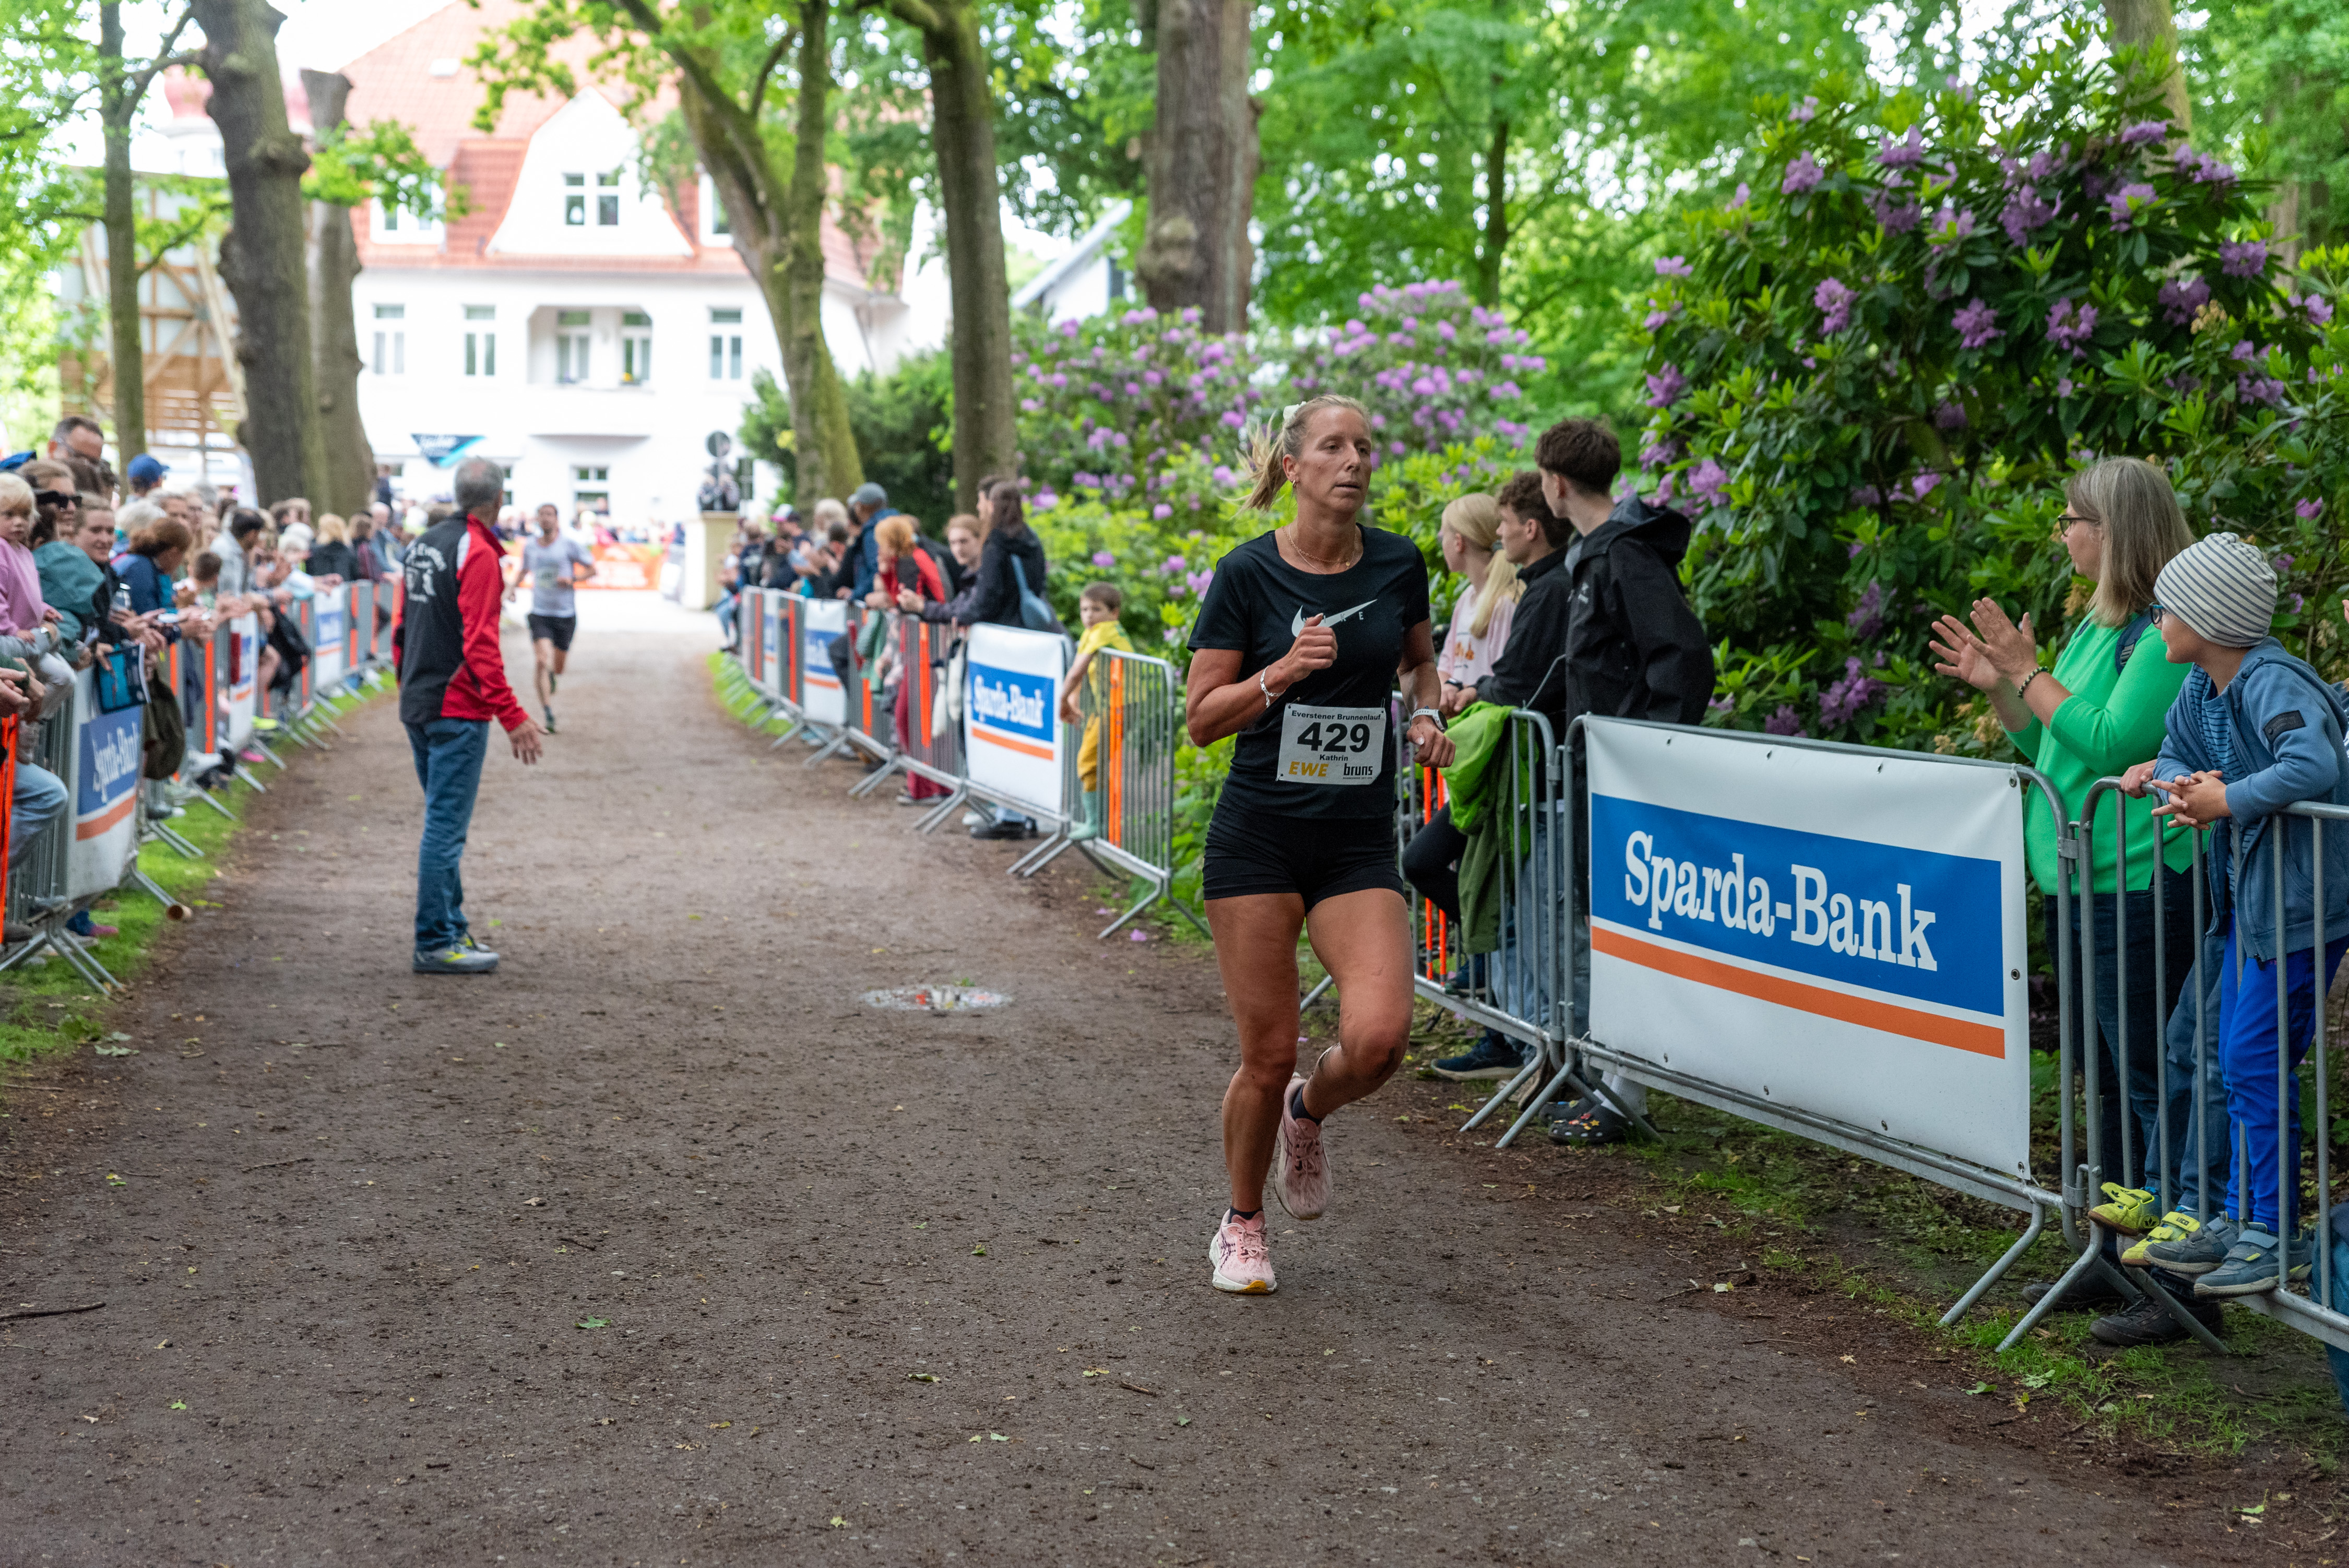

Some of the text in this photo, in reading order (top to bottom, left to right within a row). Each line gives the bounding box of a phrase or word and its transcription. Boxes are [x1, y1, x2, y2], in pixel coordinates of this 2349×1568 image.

[974, 675, 1045, 729] Sparda-Bank
[1291, 710, 1335, 720] Everstener
[1297, 722, 1370, 753] 429
[1288, 761, 1329, 777] EWE
[1344, 763, 1373, 776] bruns
[1625, 830, 1937, 971] Sparda-Bank
